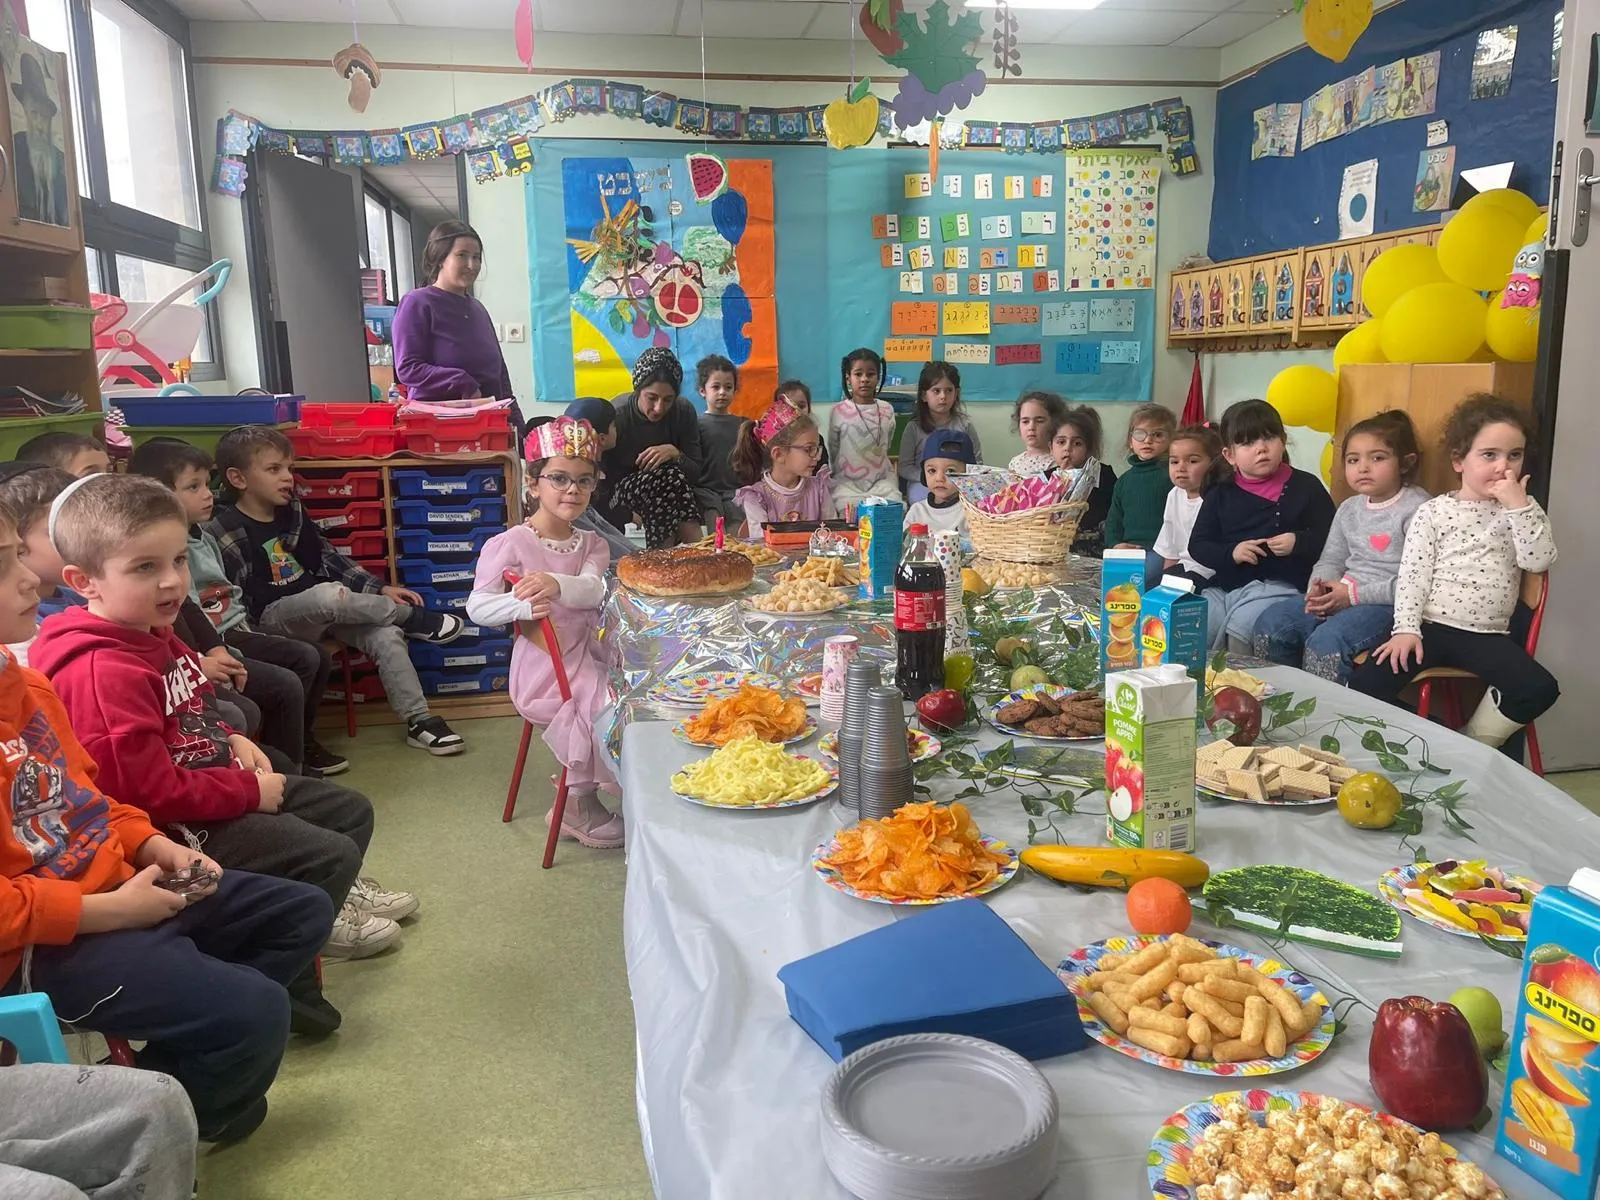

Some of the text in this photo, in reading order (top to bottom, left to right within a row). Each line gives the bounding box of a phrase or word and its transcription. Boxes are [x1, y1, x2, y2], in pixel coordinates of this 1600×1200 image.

[1428, 152, 1447, 165] שבט
[1110, 602, 1136, 610] ספרינג
[1534, 990, 1596, 1033] ספרינג
